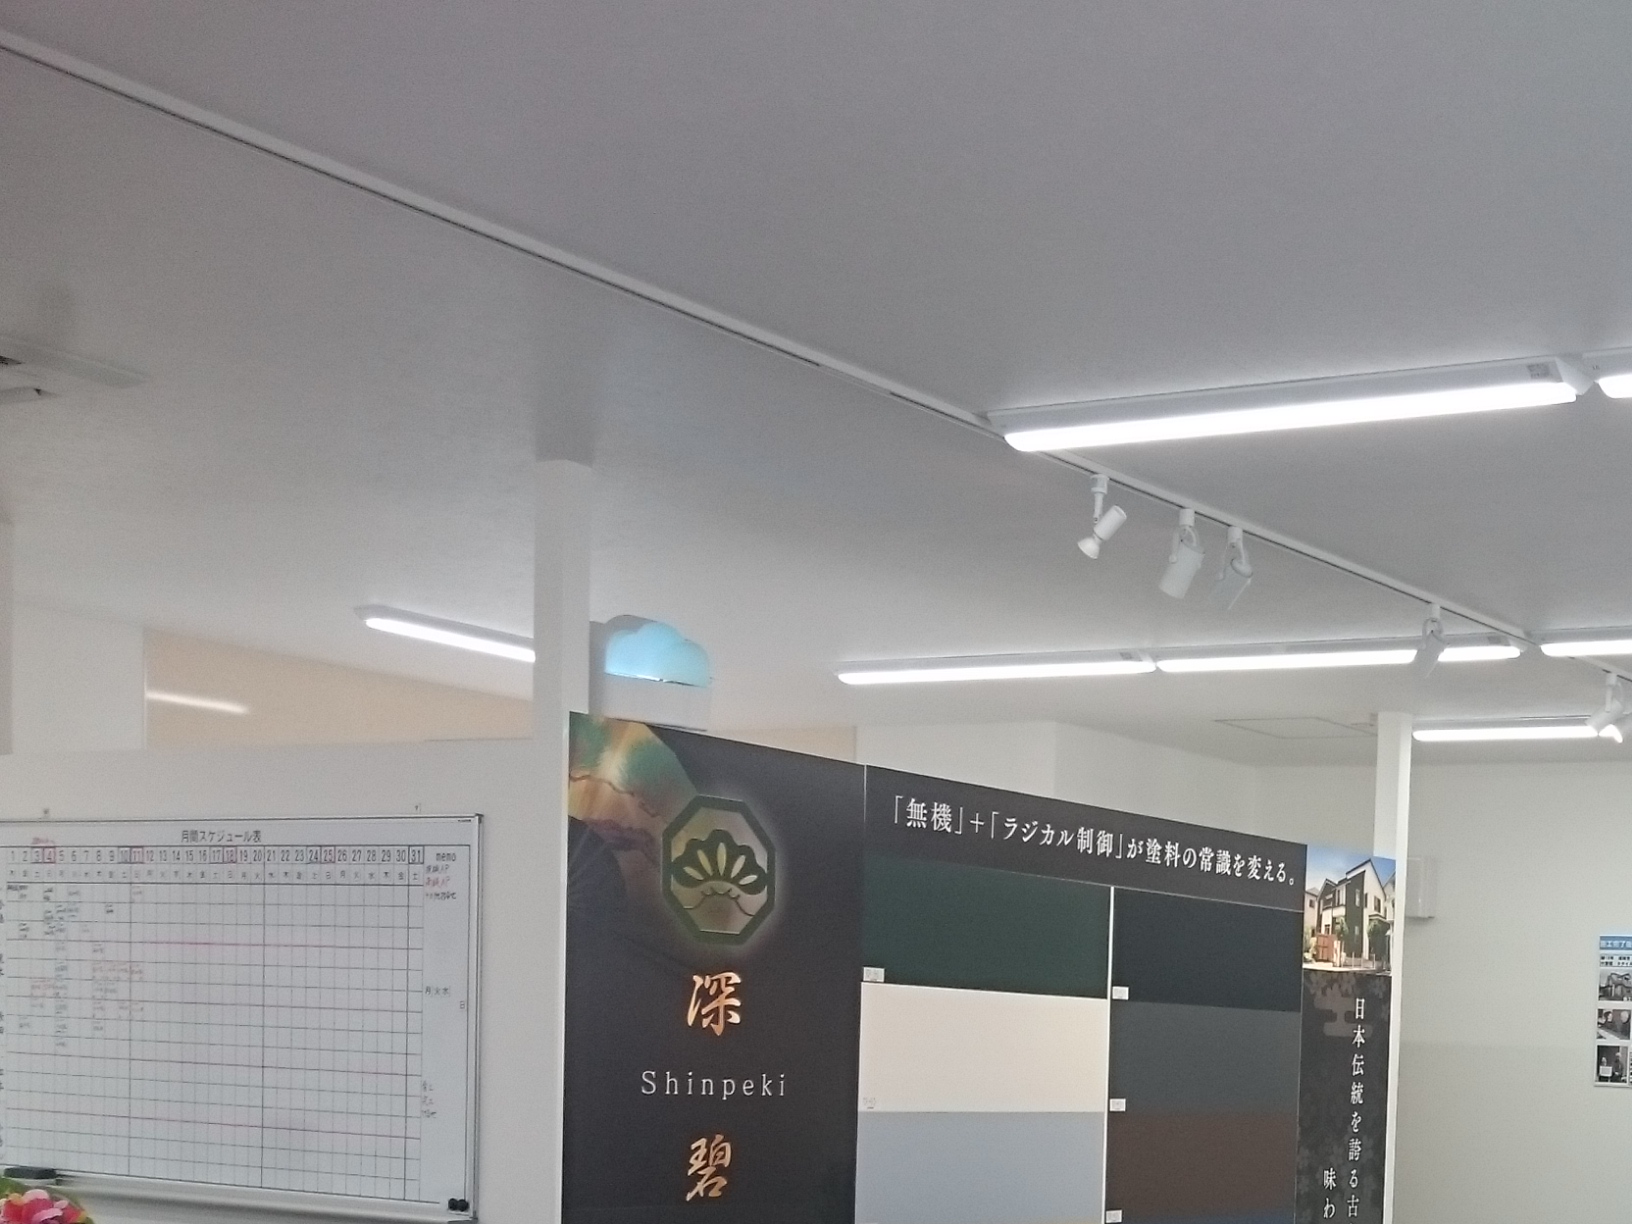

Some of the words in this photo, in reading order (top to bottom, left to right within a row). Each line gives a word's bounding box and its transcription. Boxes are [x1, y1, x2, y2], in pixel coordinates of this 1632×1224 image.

[133, 850, 140, 862] 11
[146, 850, 154, 862] 12
[159, 850, 167, 862] 13
[172, 850, 180, 862] 14
[185, 850, 193, 862] 15
[199, 850, 207, 862] 16
[212, 850, 221, 862] 17
[226, 850, 234, 862] 18
[240, 850, 248, 862] 19
[253, 850, 262, 862] 20
[266, 850, 276, 862] 21
[280, 850, 290, 862] 22
[294, 850, 304, 862] 23
[308, 850, 318, 862] 24
[323, 850, 332, 862] 25
[337, 850, 347, 862] 26
[352, 850, 362, 862] 27
[366, 850, 376, 862] 28
[381, 850, 391, 862] 29
[396, 850, 406, 862] 30
[411, 850, 421, 862] 31
[435, 852, 457, 862] memo
[687, 971, 742, 1036] 深
[640, 1070, 786, 1100] Shinpeki
[686, 1134, 732, 1201] 碧
